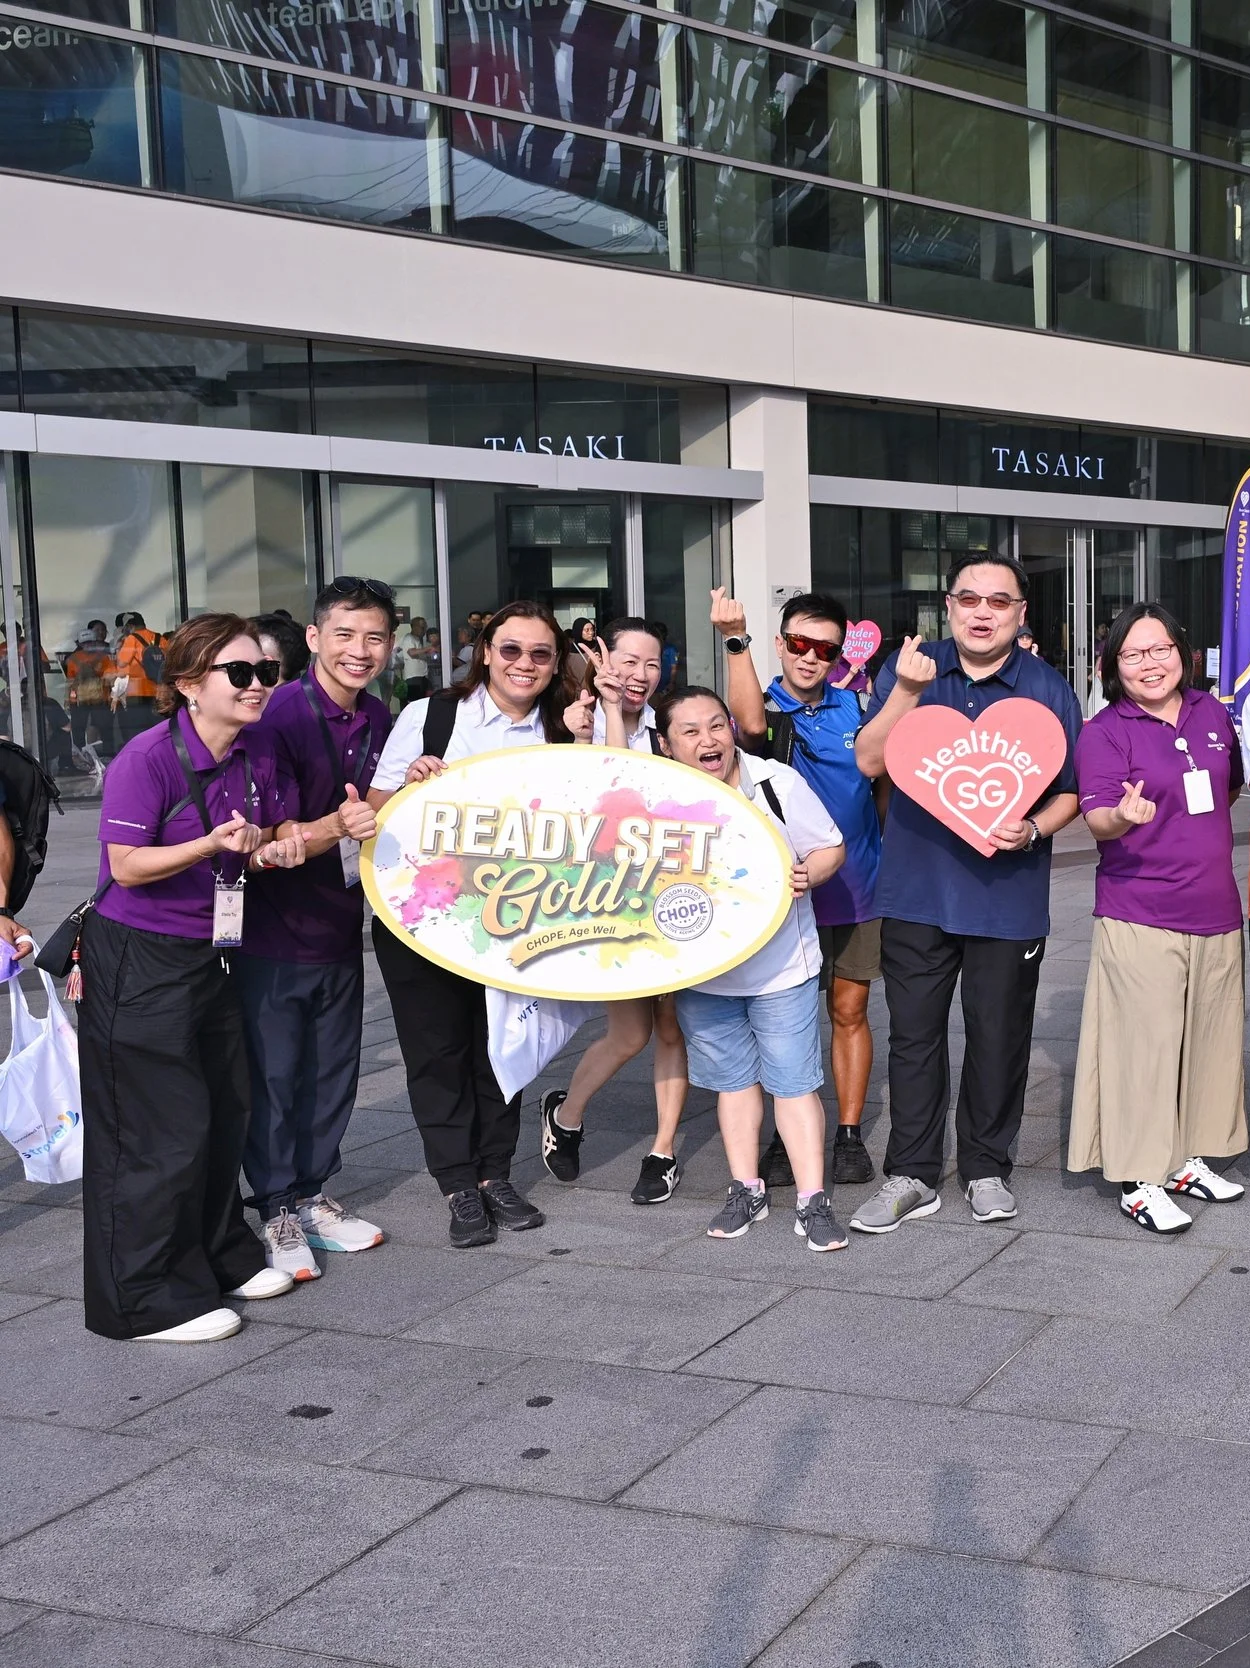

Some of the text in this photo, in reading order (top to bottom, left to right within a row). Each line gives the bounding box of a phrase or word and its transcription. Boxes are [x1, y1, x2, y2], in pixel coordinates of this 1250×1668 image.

[991, 447, 1104, 480] TASAKI
[914, 729, 1042, 785] Healthier
[957, 779, 1007, 810] SG
[421, 802, 721, 873] READY SET
[473, 856, 661, 935] Gold!
[659, 888, 702, 908] BLOSSOM SEEDS
[657, 901, 708, 923] CHOPE
[526, 926, 616, 951] CHOPE, Age Well
